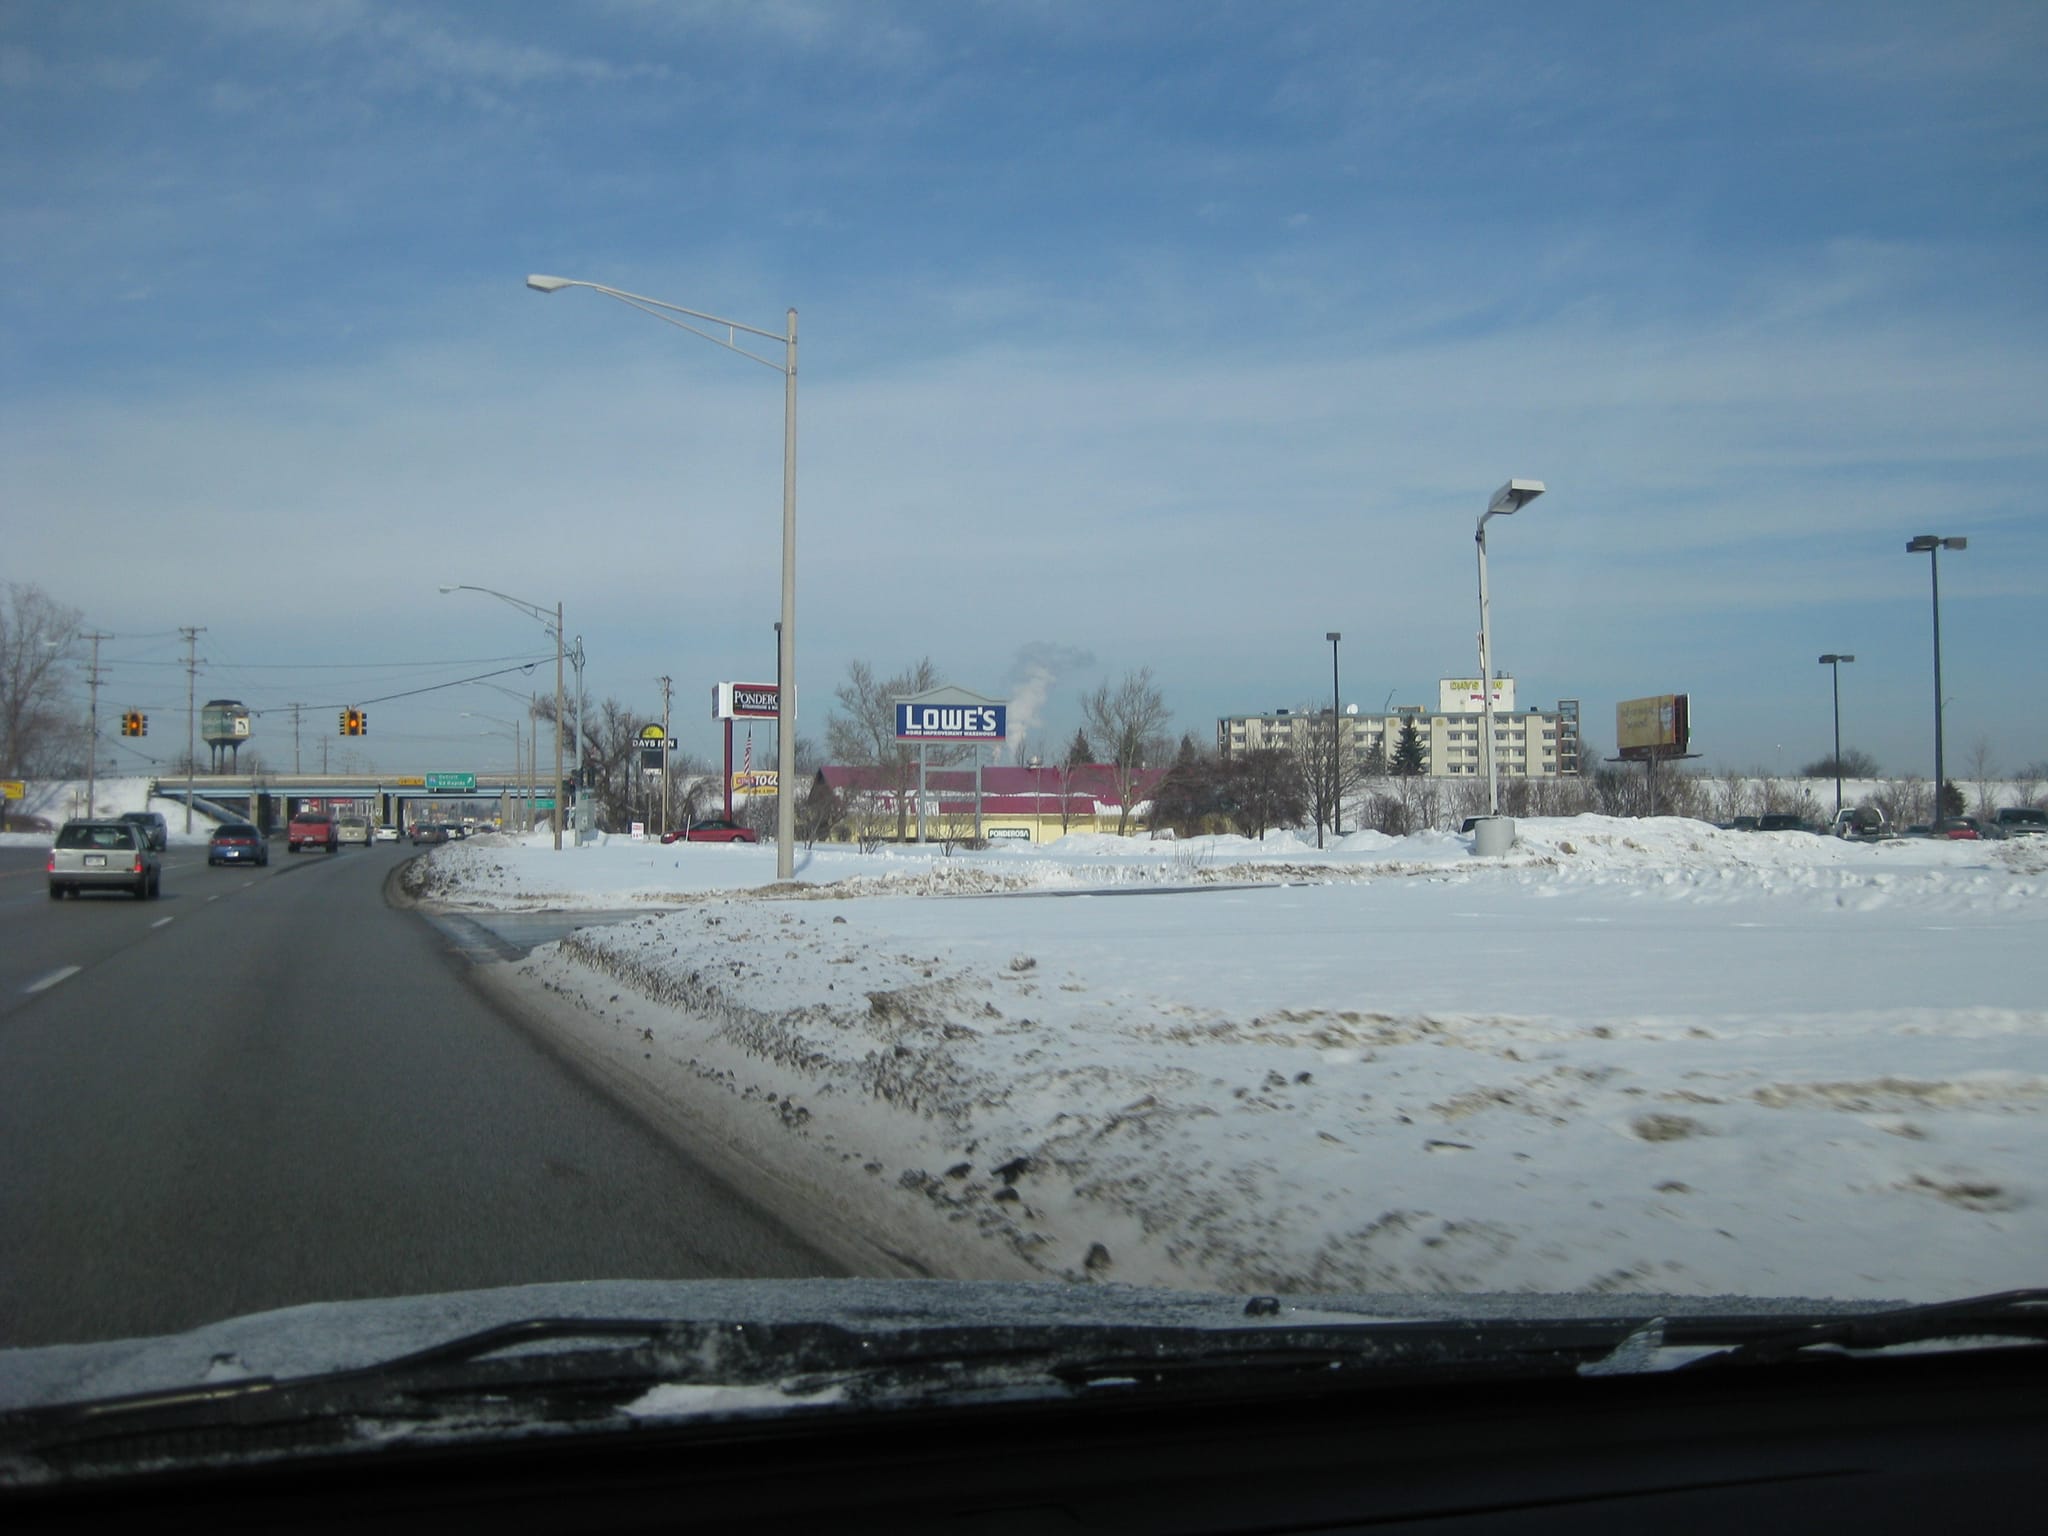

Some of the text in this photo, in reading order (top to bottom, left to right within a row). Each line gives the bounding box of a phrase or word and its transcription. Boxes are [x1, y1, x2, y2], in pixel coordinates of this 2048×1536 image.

[906, 705, 997, 731] LOWE'S
[632, 739, 675, 748] DAYS IN
